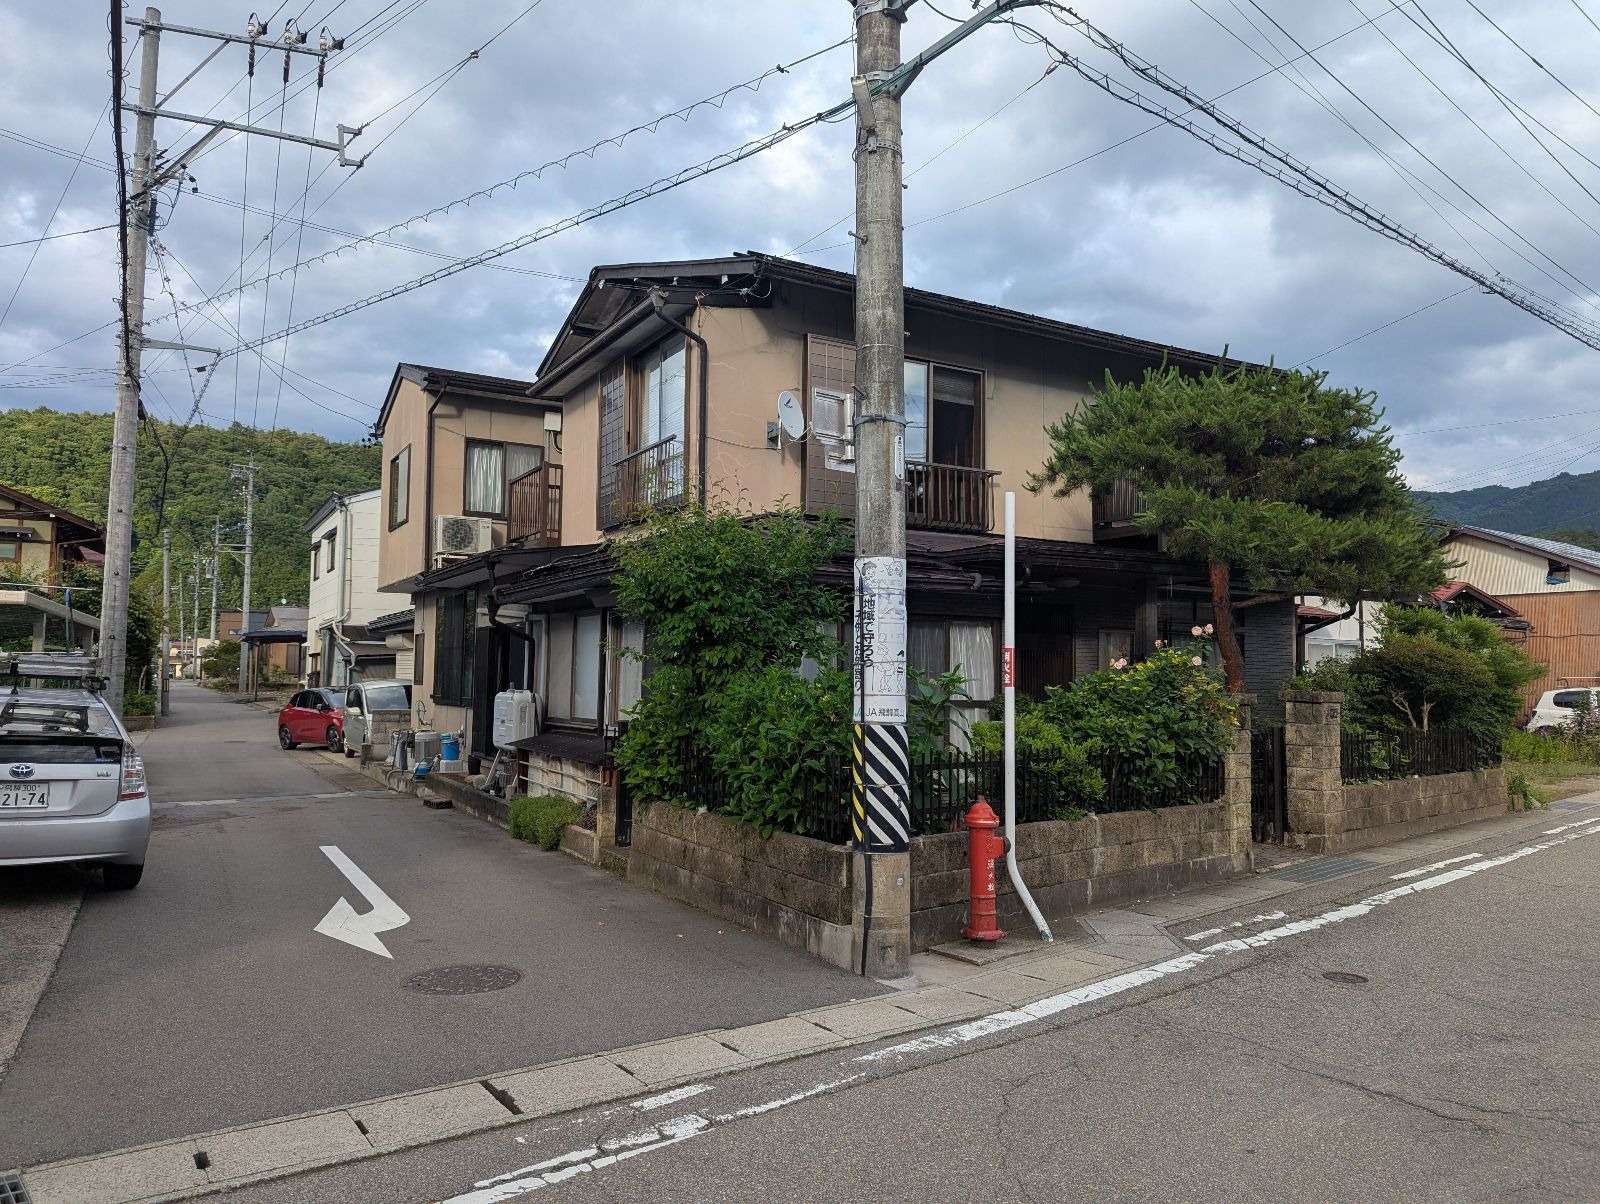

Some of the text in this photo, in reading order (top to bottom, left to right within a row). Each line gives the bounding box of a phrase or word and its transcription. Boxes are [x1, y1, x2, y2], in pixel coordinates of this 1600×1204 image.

[866, 708, 877, 717] JA
[22, 784, 36, 792] 300
[2, 793, 45, 806] 21-74
